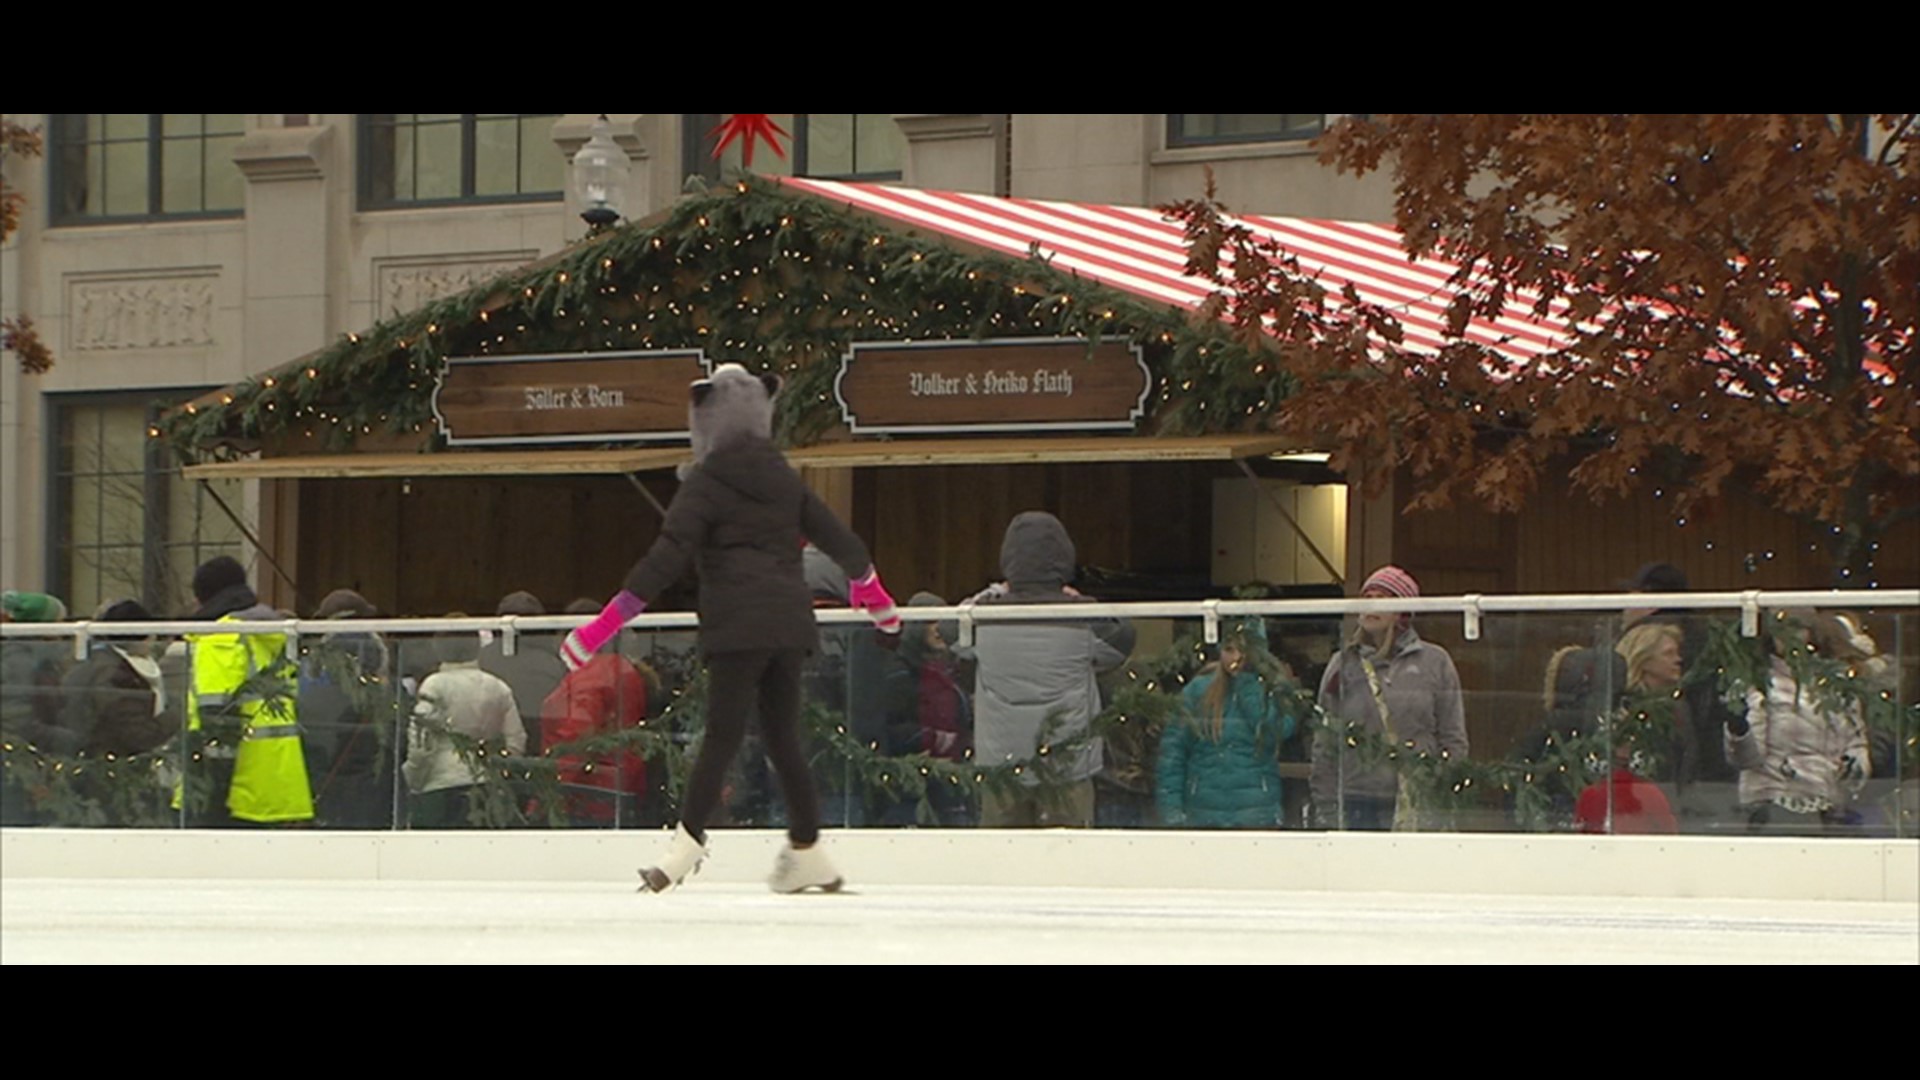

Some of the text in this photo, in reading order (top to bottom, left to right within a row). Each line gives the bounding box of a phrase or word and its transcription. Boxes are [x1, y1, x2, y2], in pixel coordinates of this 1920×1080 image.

[909, 368, 1073, 397] Volker & Heiko Flath
[571, 387, 582, 408] &
[587, 384, 624, 408] Born
